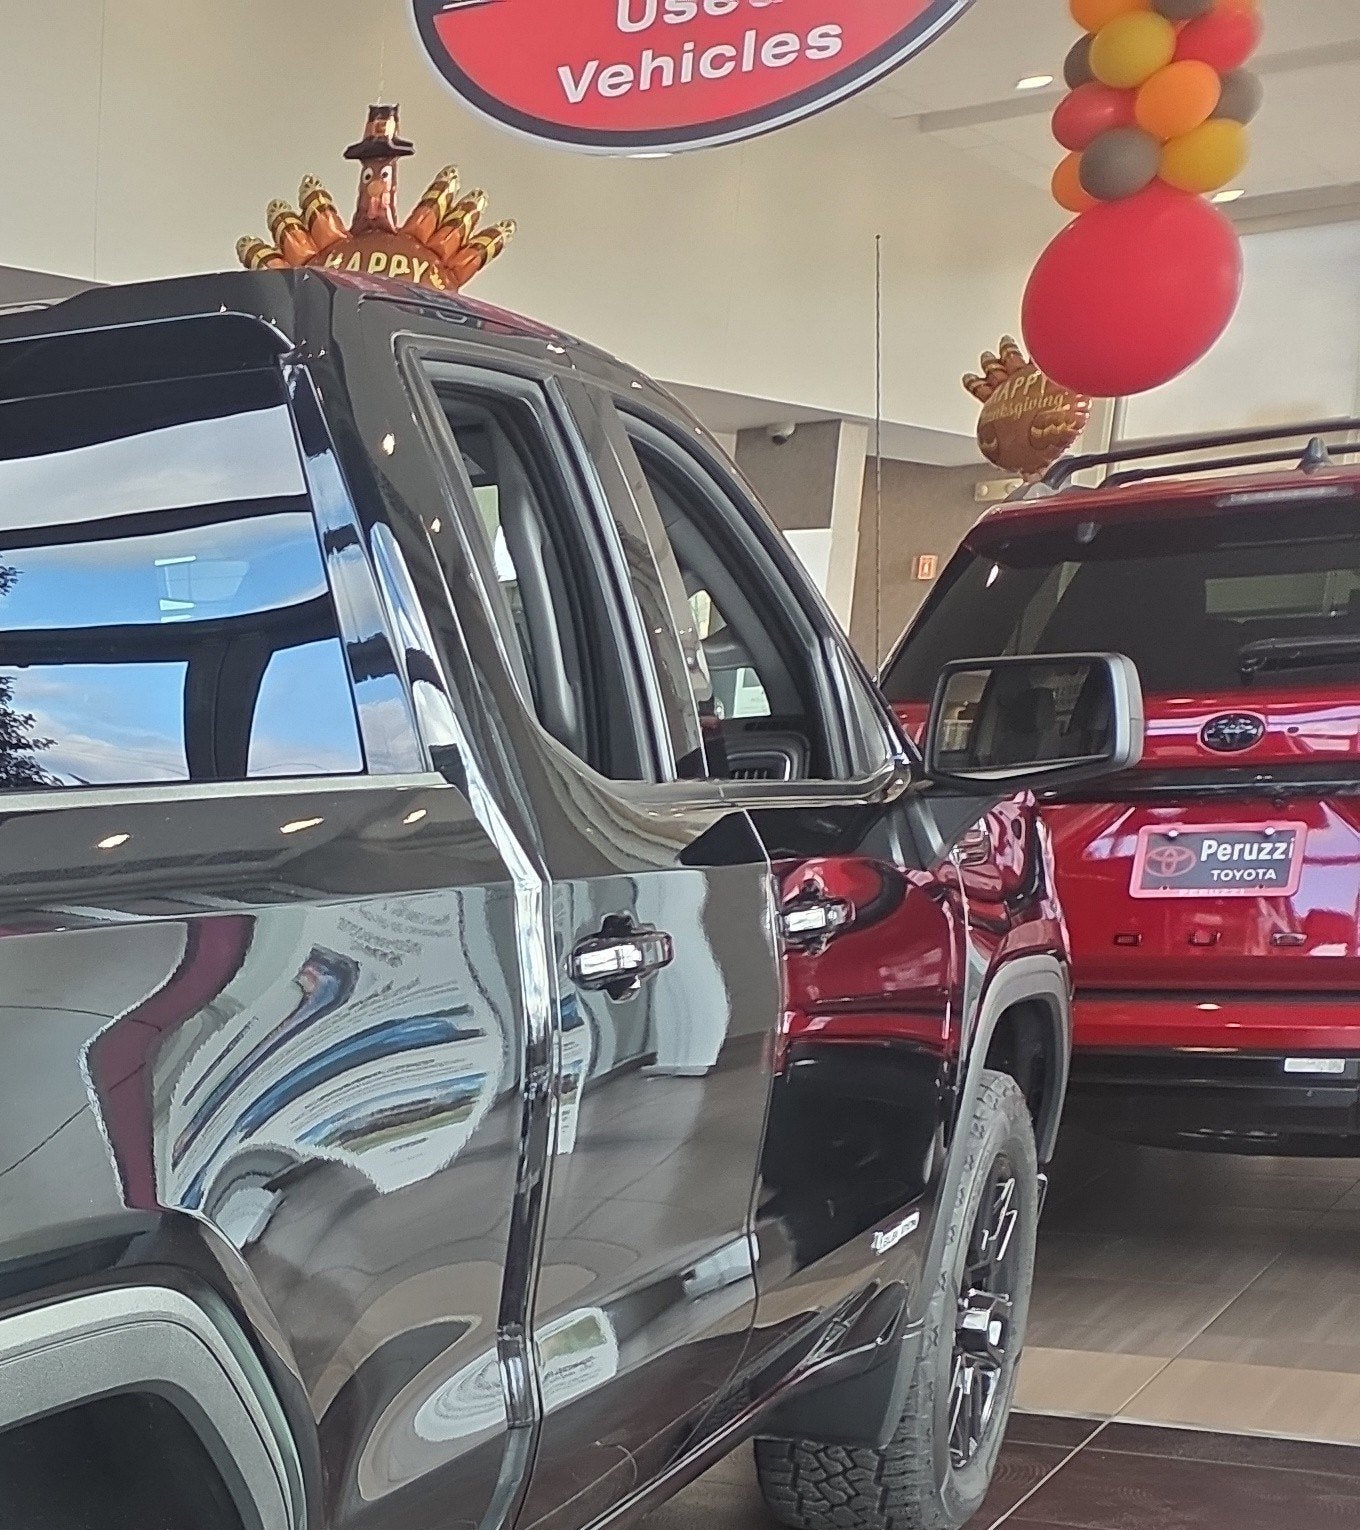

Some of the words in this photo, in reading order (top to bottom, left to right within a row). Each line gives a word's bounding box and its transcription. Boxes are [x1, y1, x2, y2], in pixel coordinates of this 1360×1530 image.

[616, 0, 781, 33] Use
[557, 23, 843, 104] Vehicles
[323, 251, 430, 284] HAPPY
[1200, 837, 1296, 862] Peruzzi
[1211, 868, 1277, 881] TOYOTA
